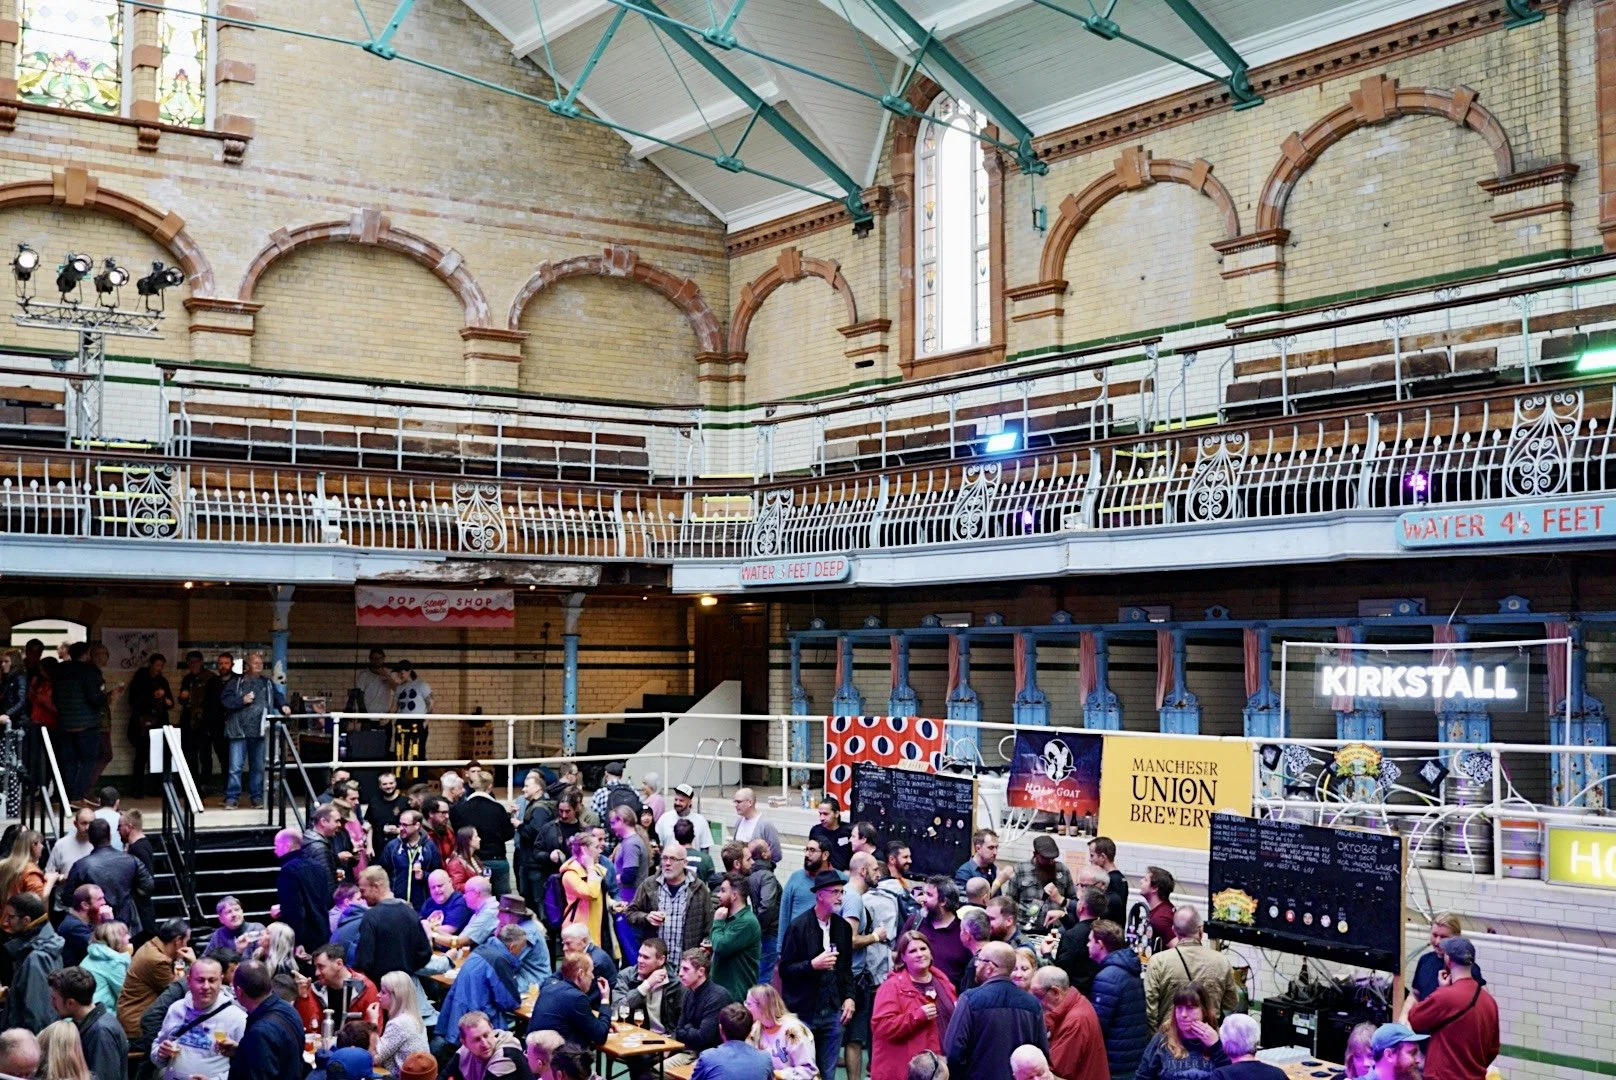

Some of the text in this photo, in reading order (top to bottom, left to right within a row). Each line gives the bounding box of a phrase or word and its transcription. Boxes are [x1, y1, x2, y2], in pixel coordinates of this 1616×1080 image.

[1403, 513, 1485, 541] WATER
[1542, 505, 1605, 533] FEET
[741, 560, 844, 580] WATER 3 FEET DEEP
[387, 596, 493, 607] POP SHOP
[1321, 665, 1518, 699] KIRKSTALL
[1132, 758, 1218, 776] MANCHESTER
[1024, 782, 1081, 798] HOLY GOAT
[1131, 775, 1218, 806] UNION
[1336, 841, 1378, 855] OKTOBER
